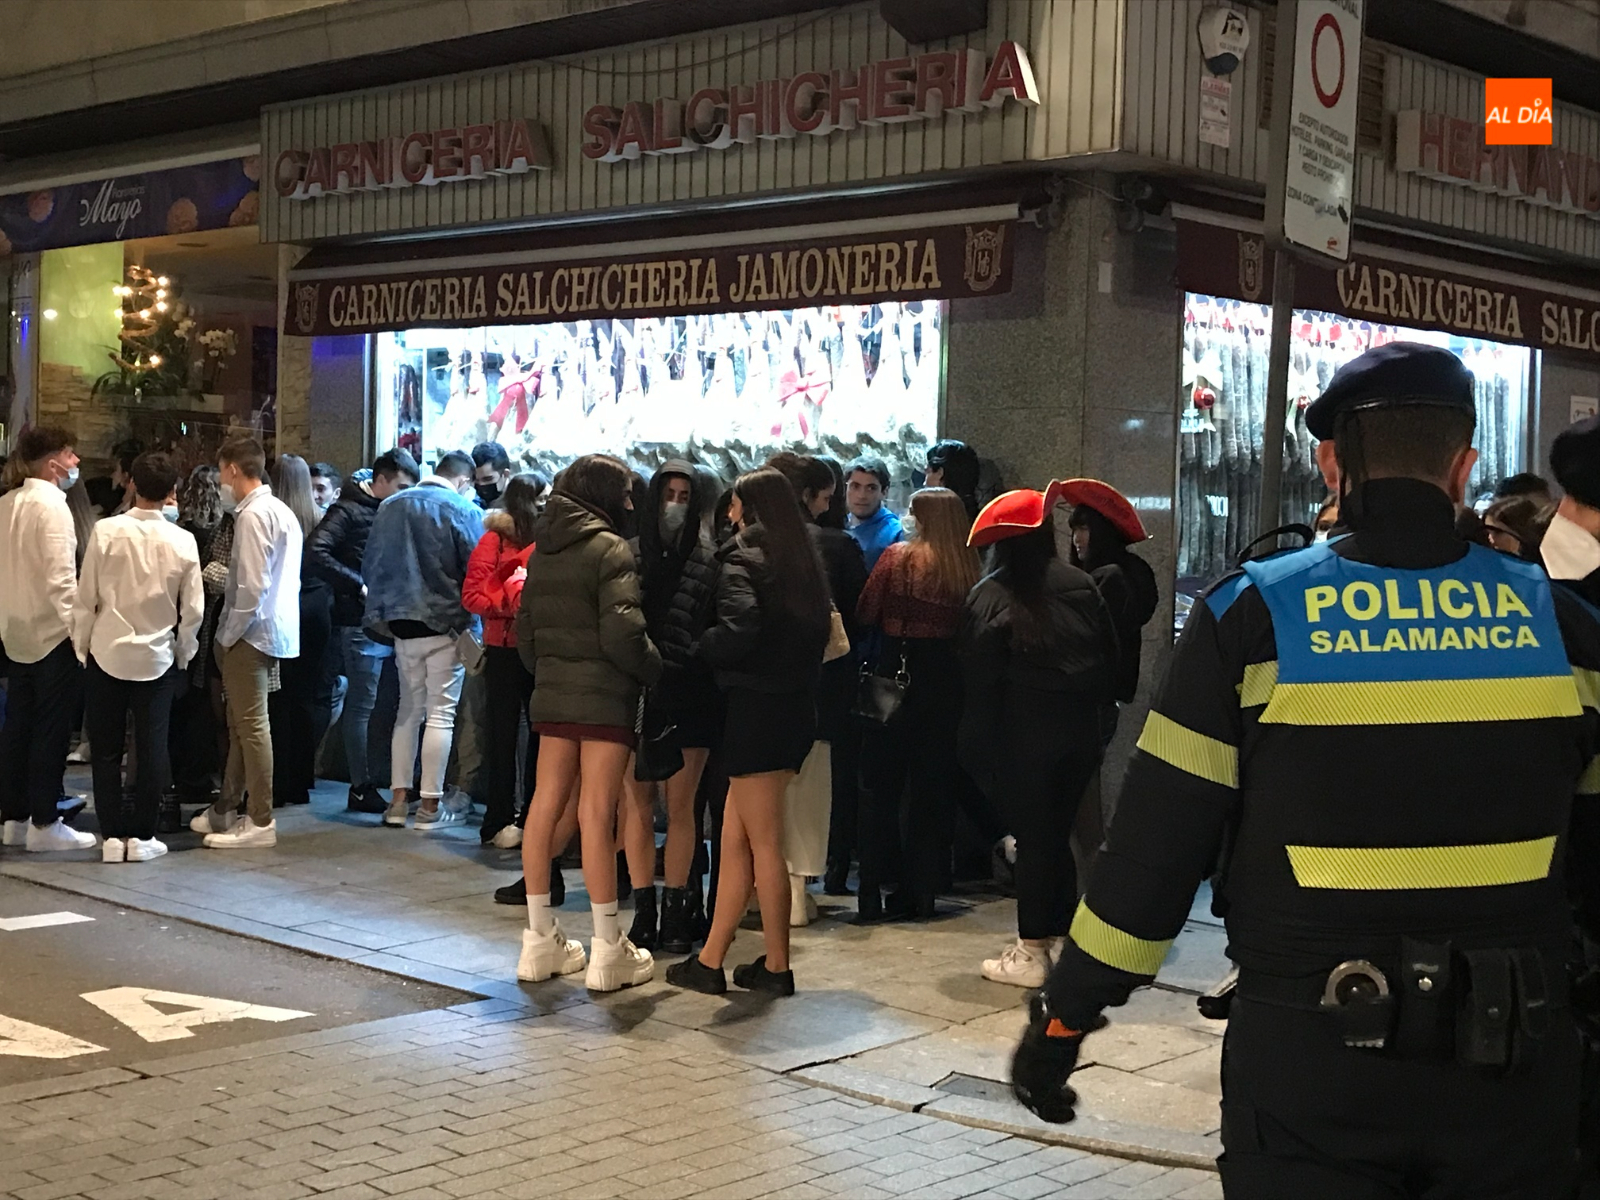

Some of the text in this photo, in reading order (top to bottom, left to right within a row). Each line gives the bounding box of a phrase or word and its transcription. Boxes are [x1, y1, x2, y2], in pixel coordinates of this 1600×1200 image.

[275, 41, 1038, 198] CARNICERIA SALCHICHERIA
[80, 180, 142, 239] Mayo
[329, 275, 487, 328] CARNICERIA
[495, 257, 720, 318] SALCHICHERIA
[729, 238, 942, 303] JAMONERIA
[1336, 261, 1524, 339] CARNICERIA
[1304, 579, 1533, 623] POLICIA
[1310, 625, 1541, 654] SALAMANCA
